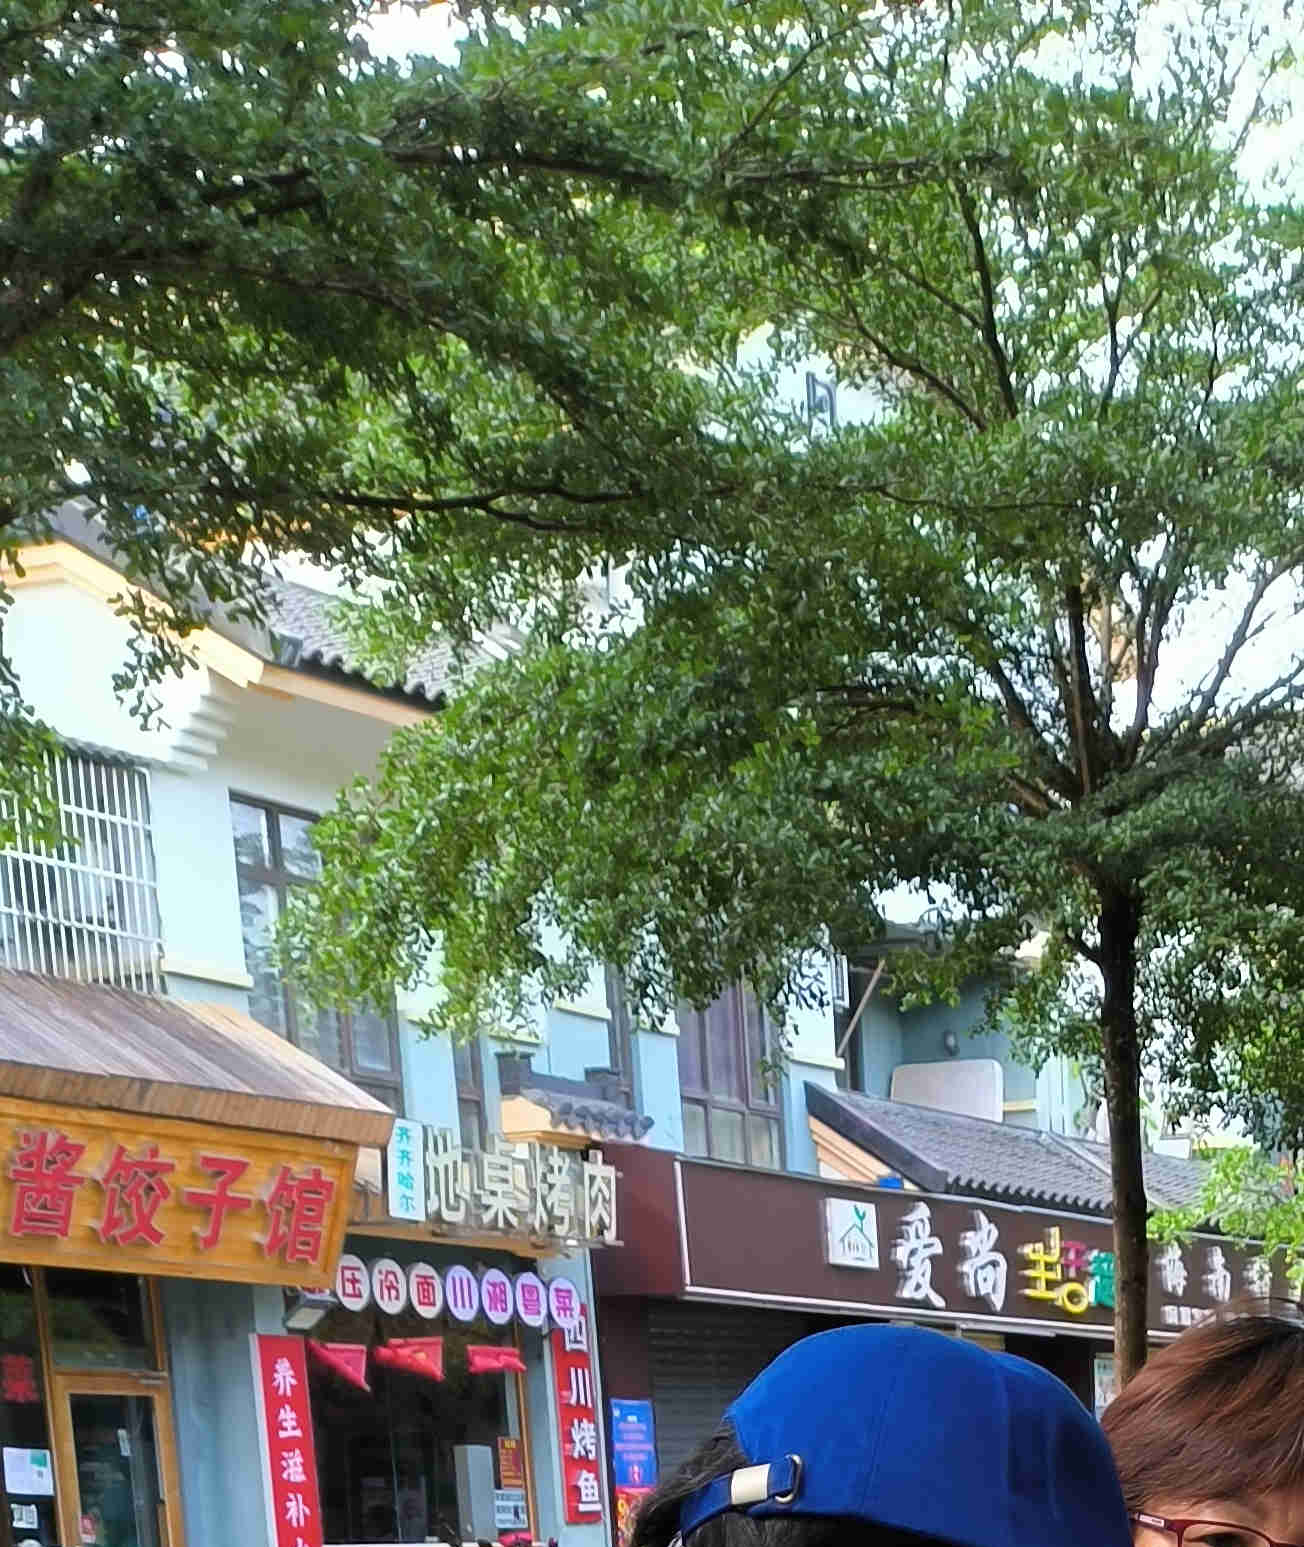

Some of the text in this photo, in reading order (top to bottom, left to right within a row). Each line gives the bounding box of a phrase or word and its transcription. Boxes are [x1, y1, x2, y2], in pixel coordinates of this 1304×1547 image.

[8, 1128, 338, 1266] 酱饺子馆
[426, 1124, 618, 1243] 地桌烤肉
[302, 1262, 574, 1321] 压冷面川湘粤菜
